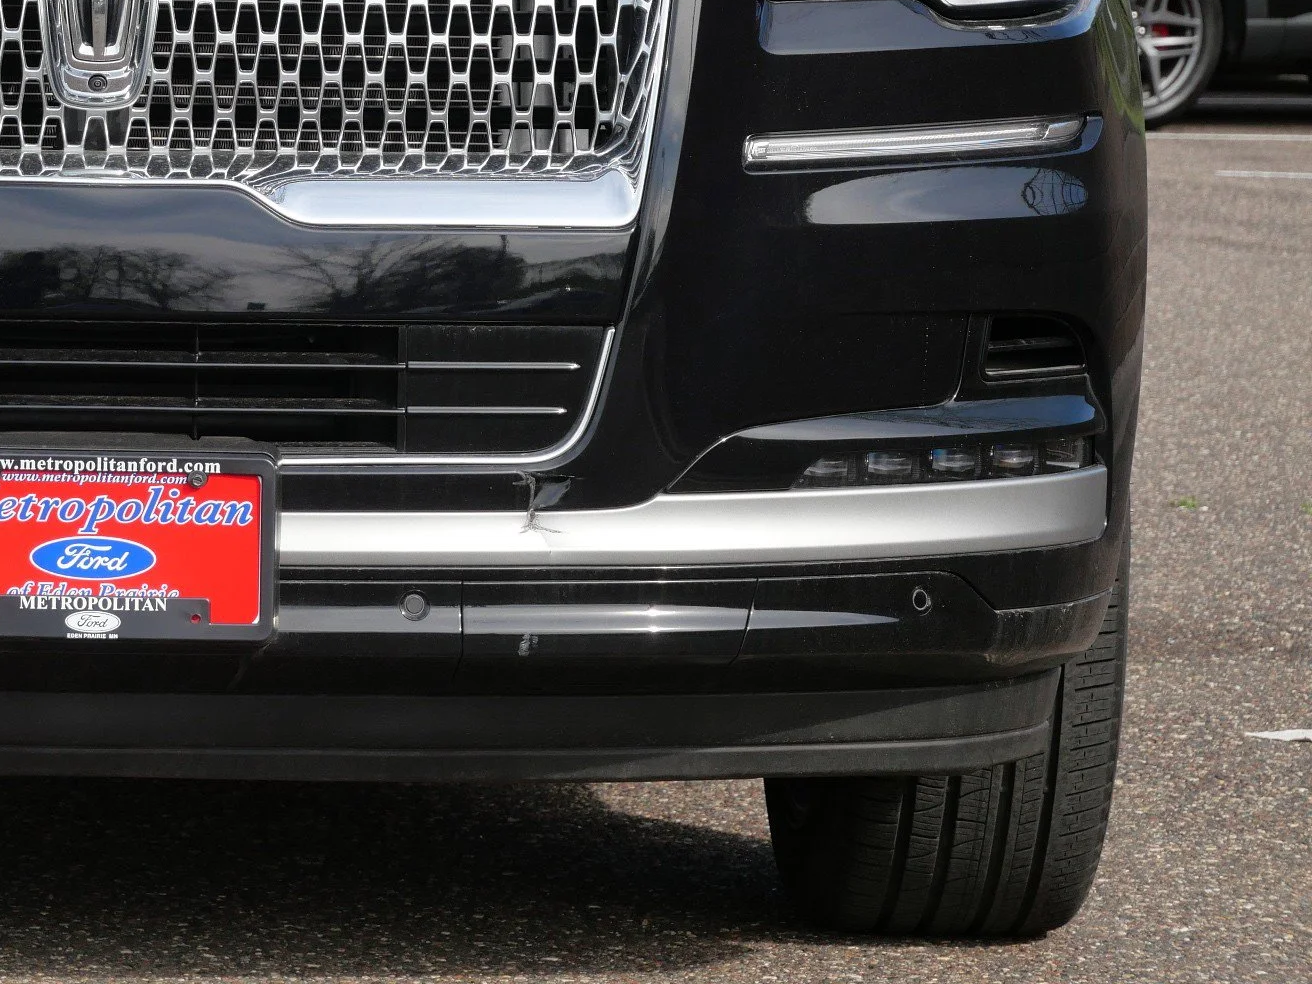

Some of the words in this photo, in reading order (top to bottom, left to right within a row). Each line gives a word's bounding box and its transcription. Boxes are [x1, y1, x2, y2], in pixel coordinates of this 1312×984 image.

[1, 472, 188, 486] www.metropolitanford.com
[56, 543, 128, 572] Ford
[19, 595, 168, 612] METROPOLITAN
[77, 614, 109, 628] Ford
